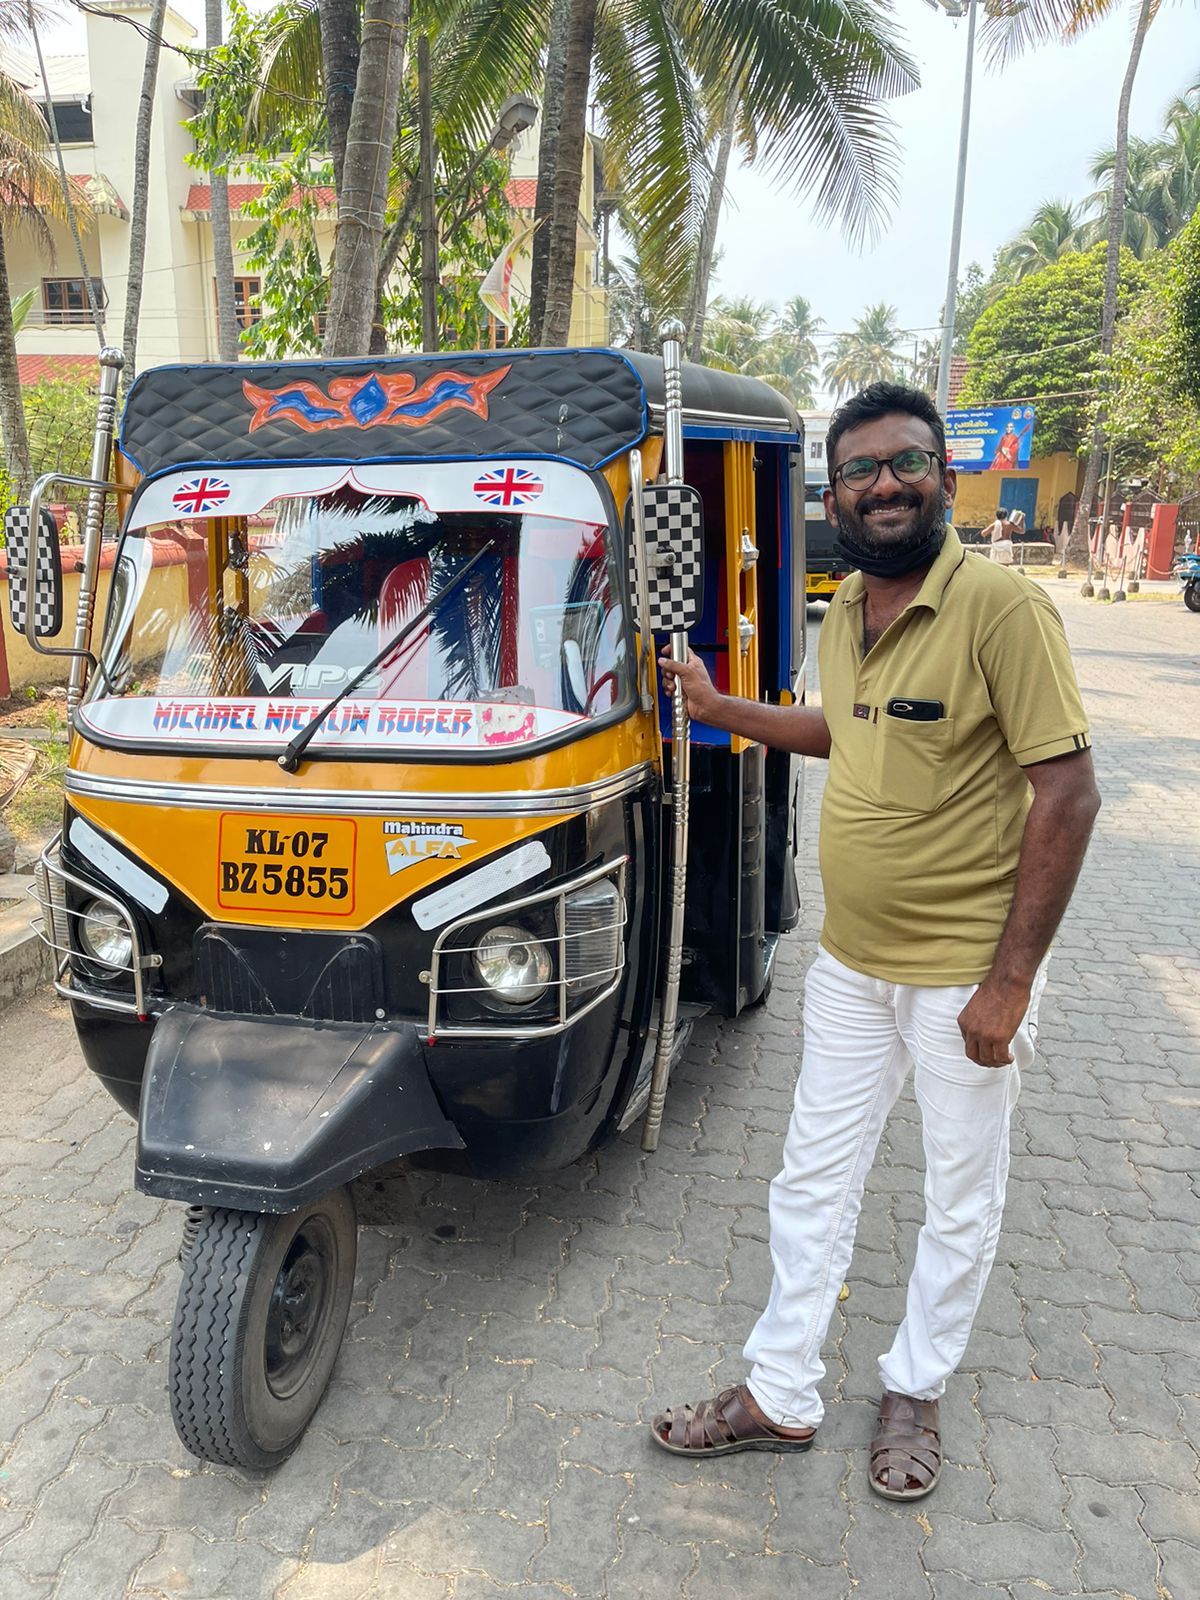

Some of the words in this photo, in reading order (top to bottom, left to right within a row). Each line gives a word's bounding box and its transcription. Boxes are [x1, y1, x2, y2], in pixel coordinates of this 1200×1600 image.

[256, 663, 384, 695] VIPS
[153, 701, 258, 732] MICHAEL
[377, 707, 473, 737] ROGER
[384, 821, 463, 835] Mahindra
[389, 839, 462, 859] ALFA
